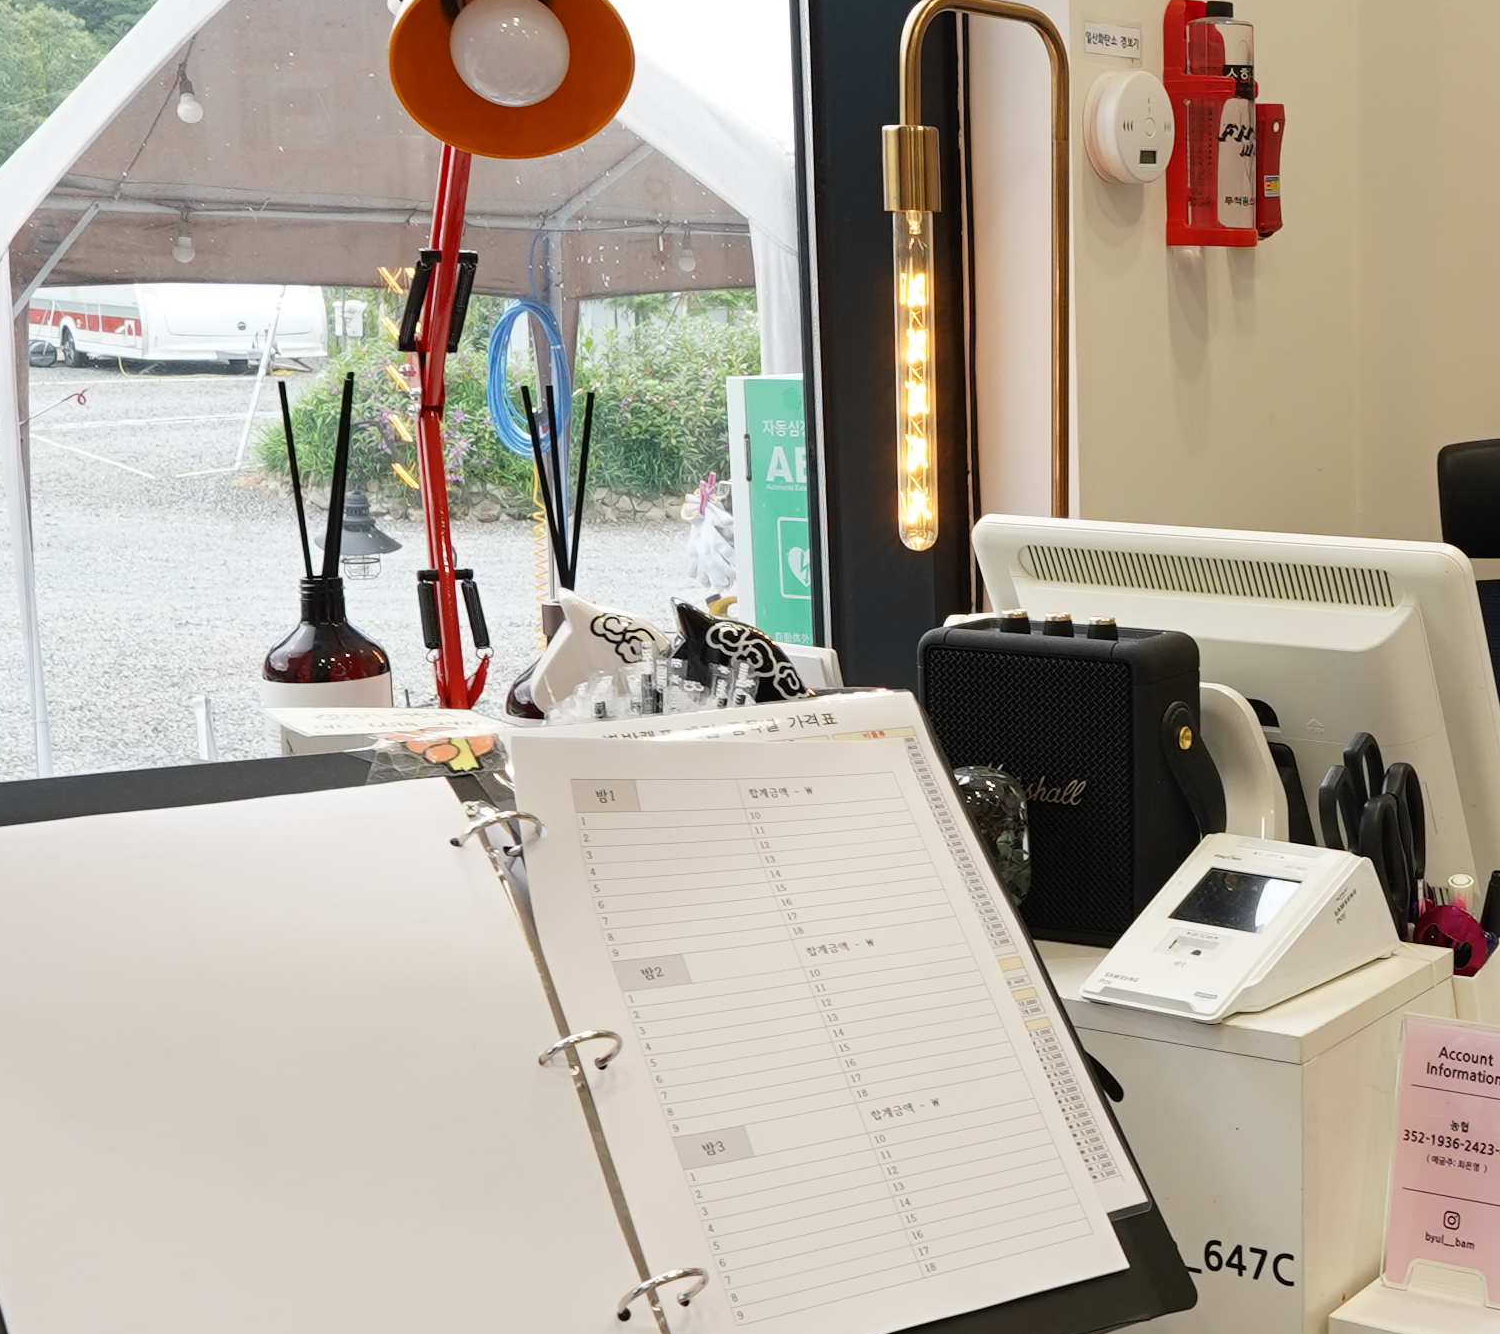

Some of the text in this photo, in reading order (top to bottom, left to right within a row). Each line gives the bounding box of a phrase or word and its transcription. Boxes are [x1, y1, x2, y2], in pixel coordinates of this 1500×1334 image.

[1086, 31, 1139, 50] 일산화탄소 경보기
[594, 788, 618, 805] 밤1
[1022, 780, 1087, 806] shall
[1438, 1046, 1494, 1067] Account
[1450, 1120, 1469, 1133] 농협
